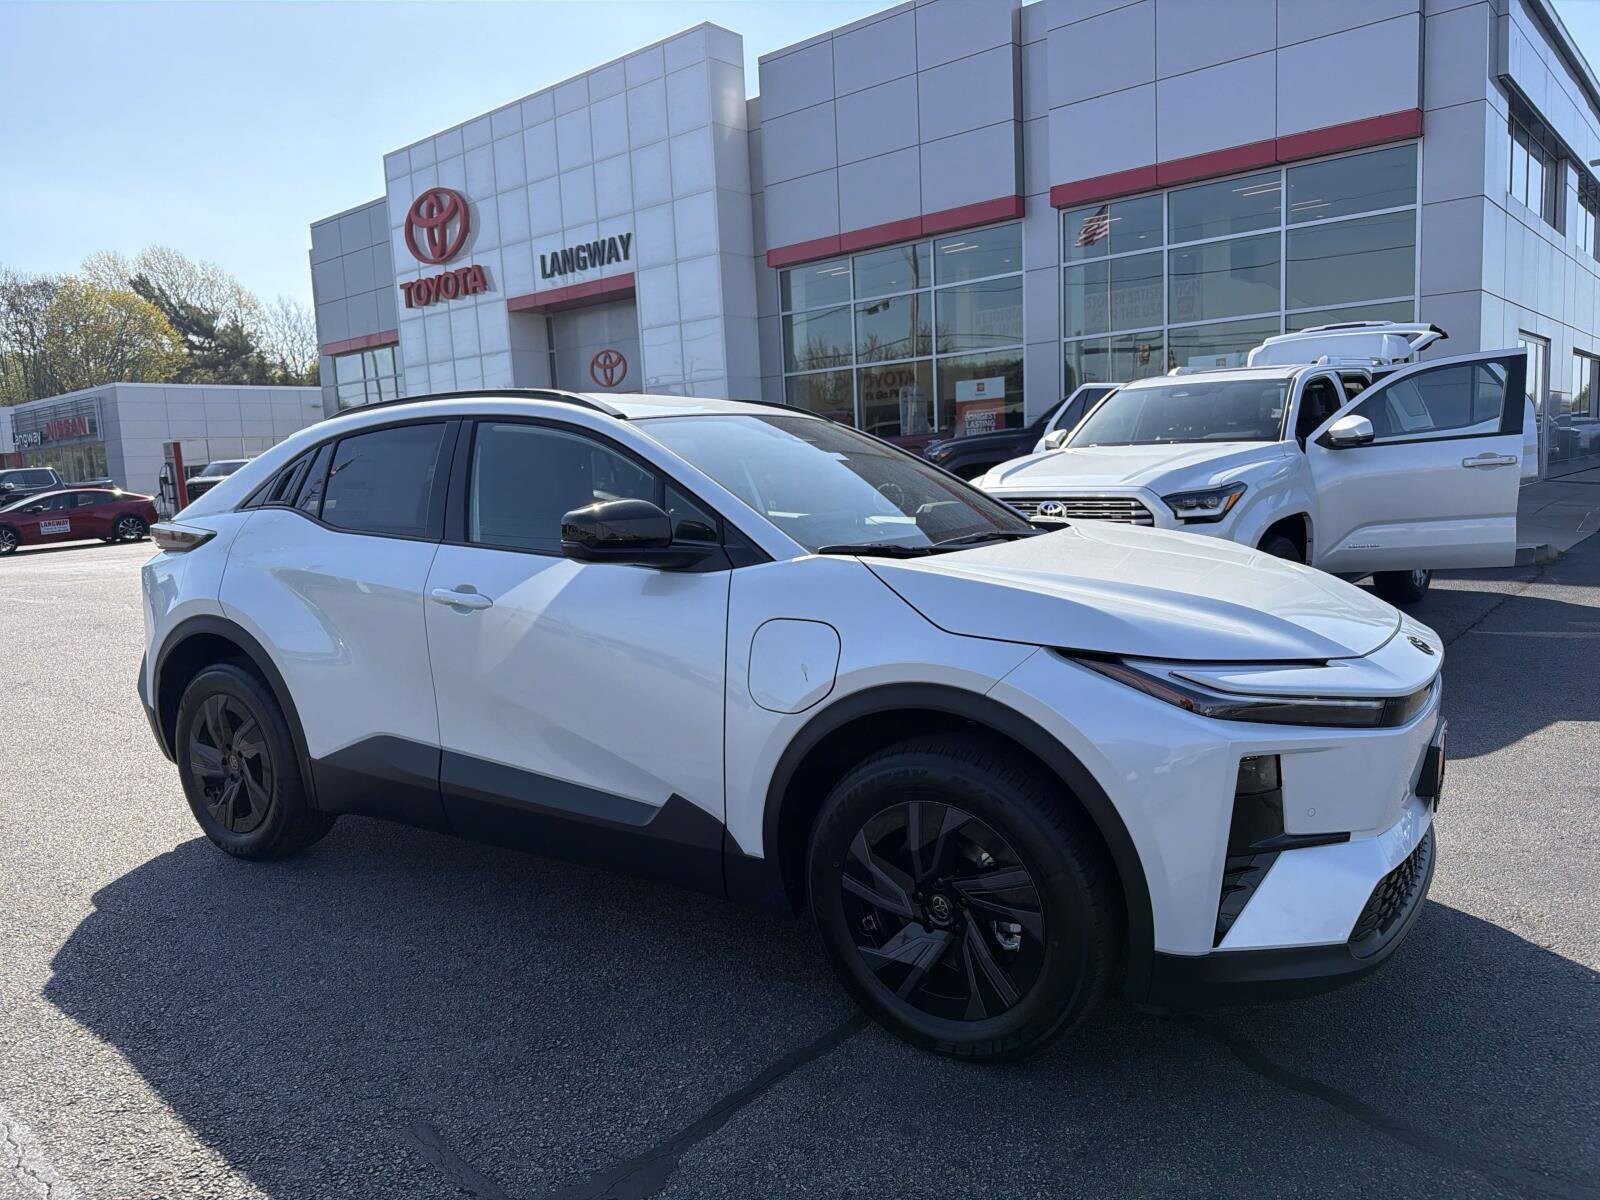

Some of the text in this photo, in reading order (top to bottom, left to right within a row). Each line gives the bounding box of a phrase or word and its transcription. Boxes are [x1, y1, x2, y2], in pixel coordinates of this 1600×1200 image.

[540, 233, 632, 279] LANGWAY
[400, 264, 488, 309] TOYOTA
[46, 416, 90, 440] NISSAN
[965, 419, 996, 429] LASTING
[41, 520, 69, 528] LANGWAY
